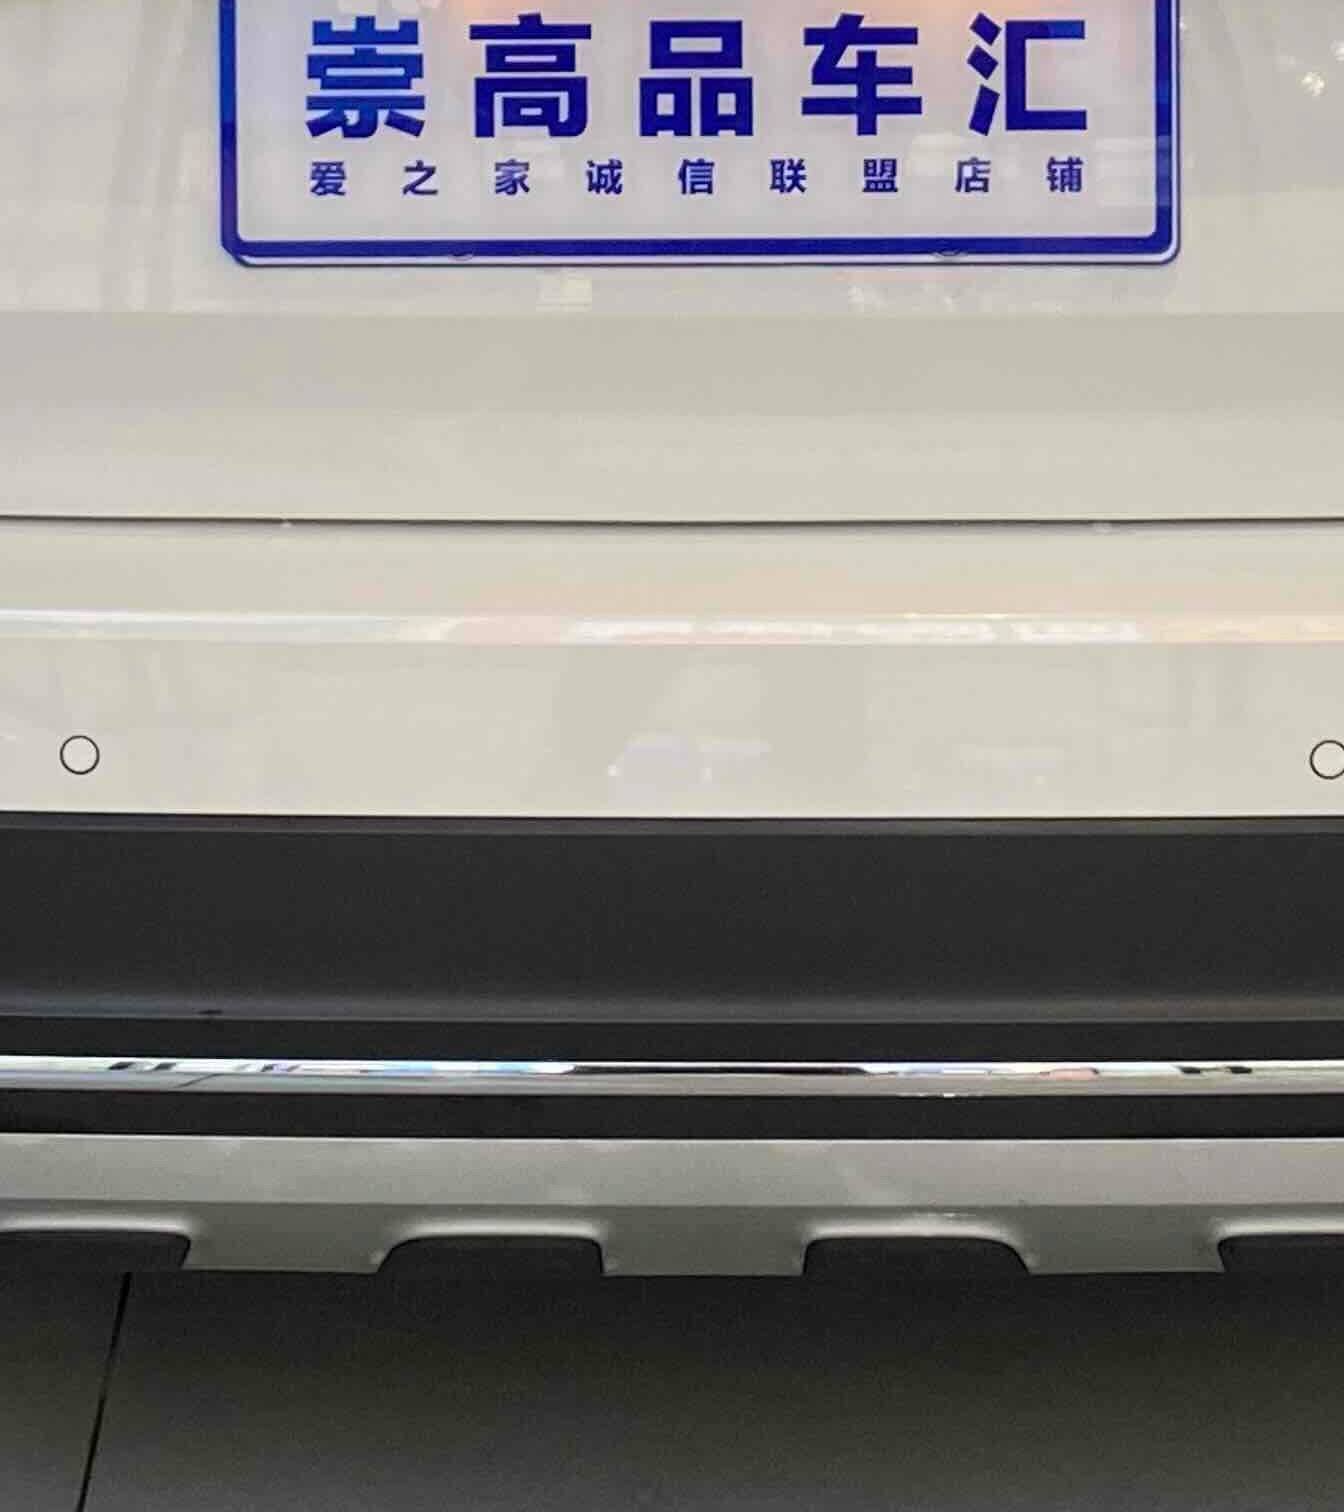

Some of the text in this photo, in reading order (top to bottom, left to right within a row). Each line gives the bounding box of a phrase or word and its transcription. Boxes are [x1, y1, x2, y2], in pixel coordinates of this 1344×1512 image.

[305, 13, 1088, 139] 崇高品车汇
[310, 158, 1085, 196] 爱之家诚信联盟店铺
